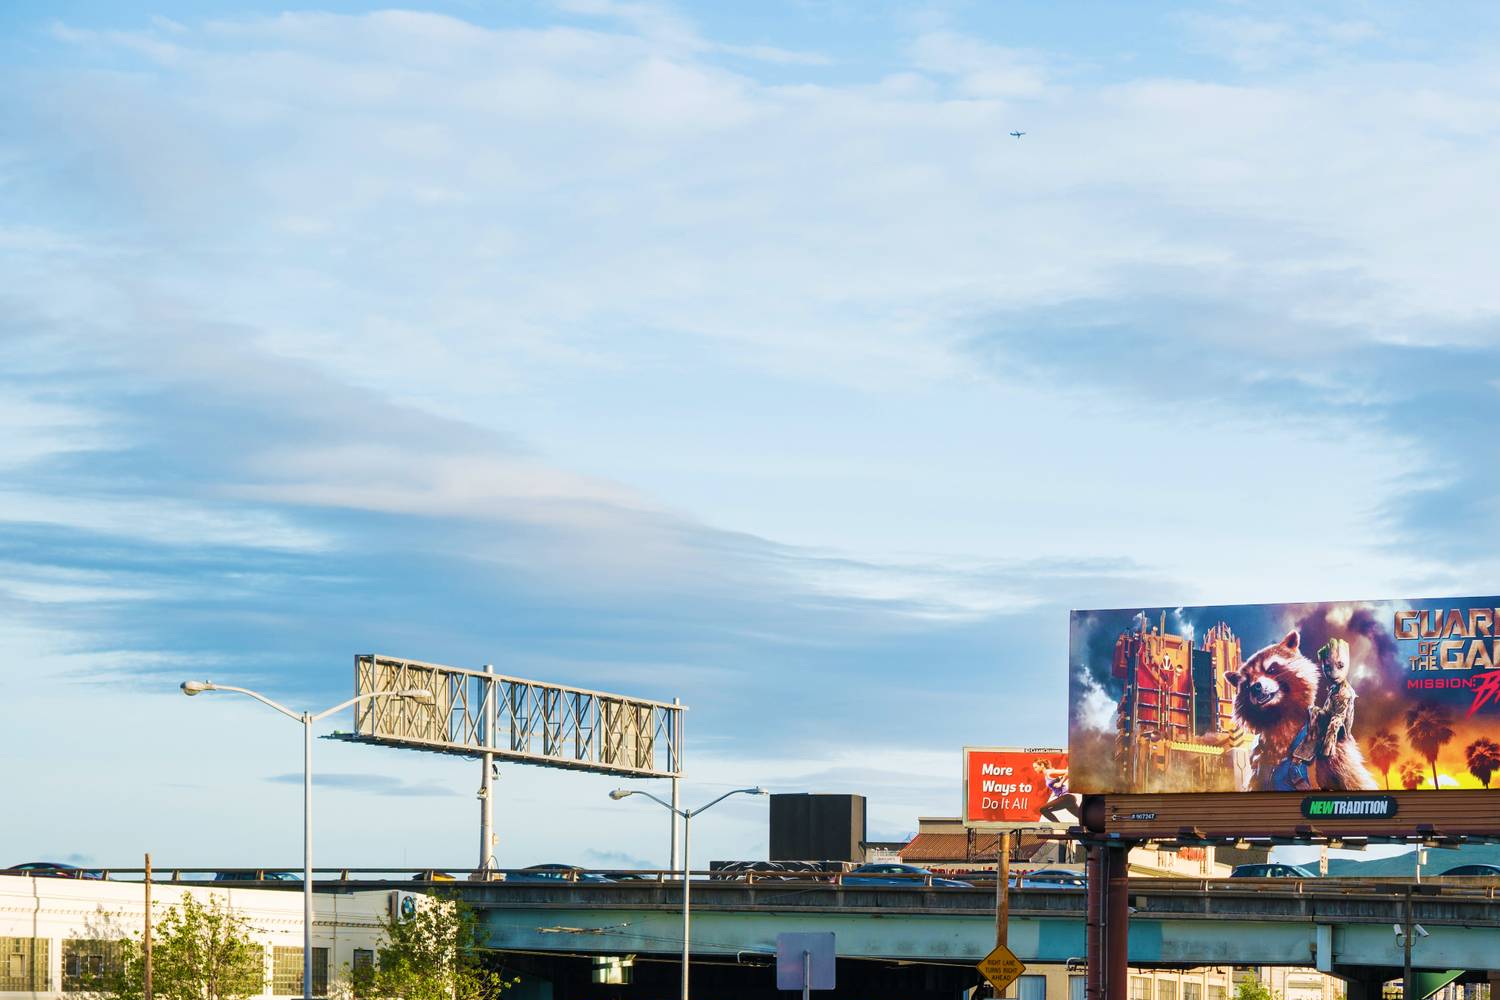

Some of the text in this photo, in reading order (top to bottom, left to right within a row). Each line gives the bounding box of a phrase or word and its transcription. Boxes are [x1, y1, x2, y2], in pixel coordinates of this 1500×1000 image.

[1417, 641, 1440, 655] OF
[1409, 656, 1440, 671] THE
[1407, 678, 1477, 689] MISSION:
[982, 763, 1013, 775] More
[982, 780, 1032, 796] Ways to
[982, 797, 1028, 809] Do It All
